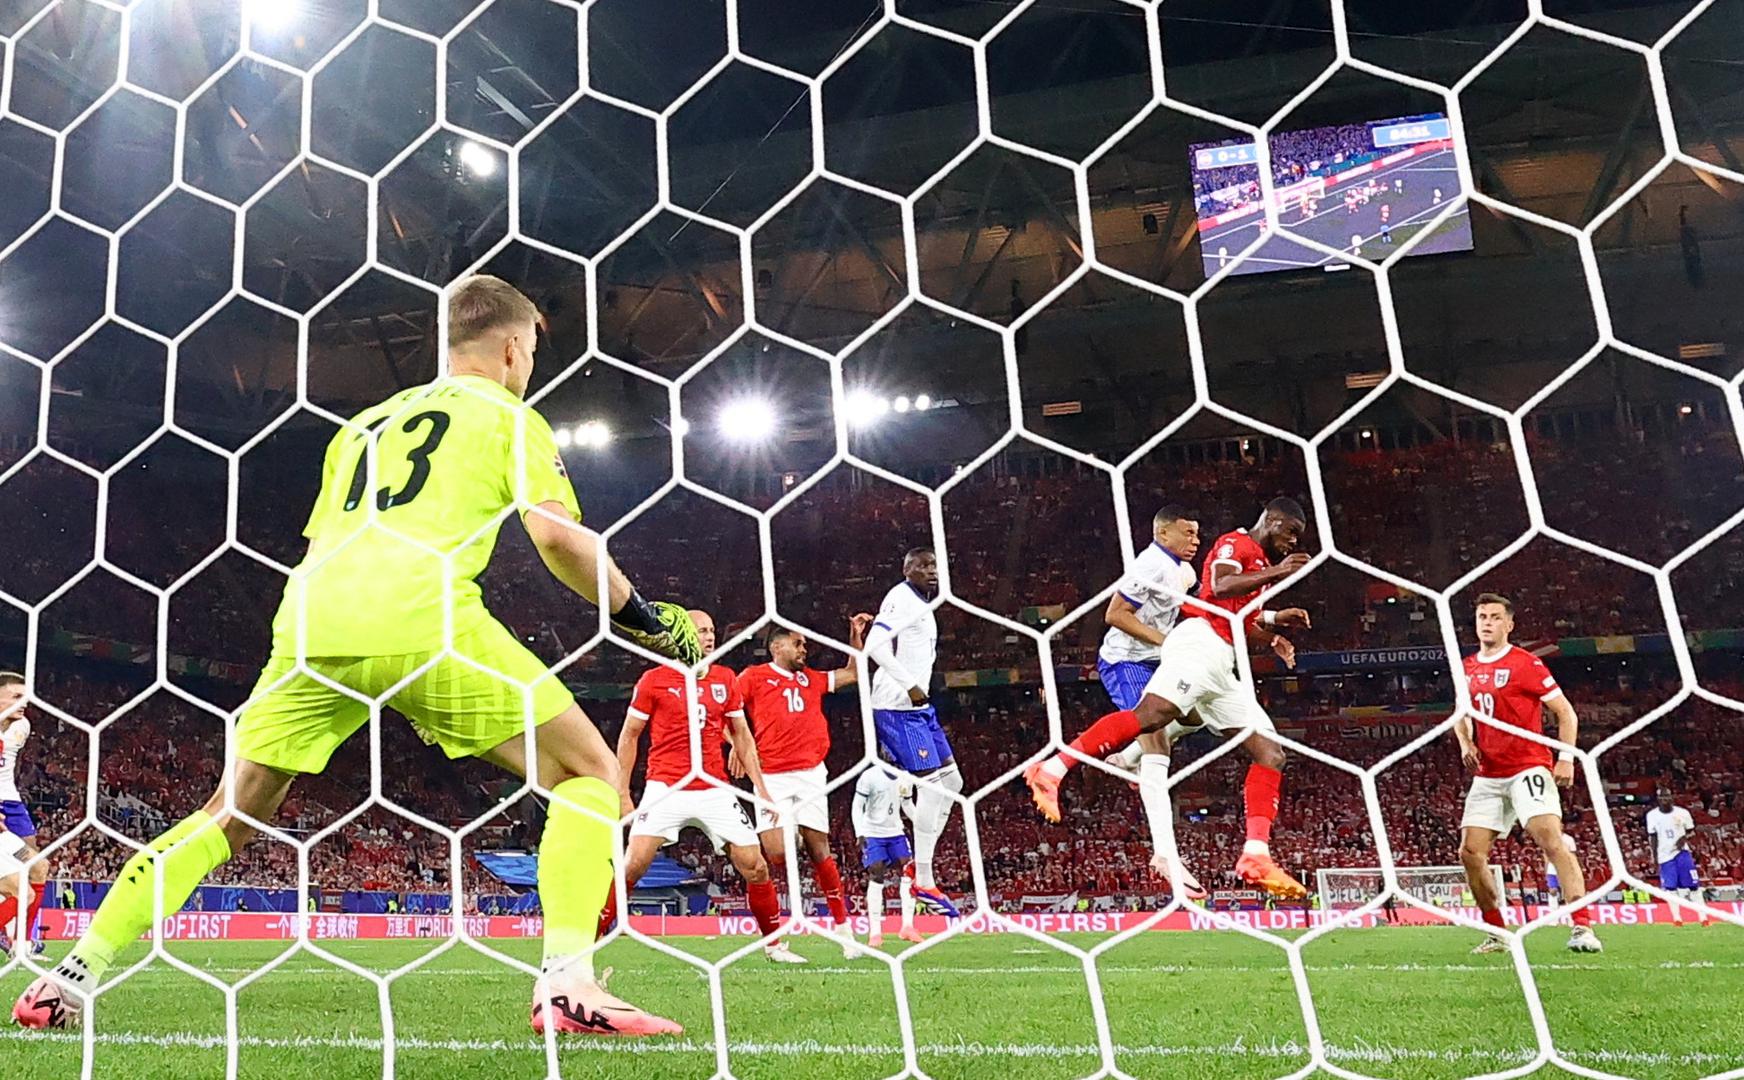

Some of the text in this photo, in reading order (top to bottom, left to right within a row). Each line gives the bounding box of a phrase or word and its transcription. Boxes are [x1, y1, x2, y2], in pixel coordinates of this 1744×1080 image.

[343, 410, 450, 512] 13
[782, 687, 805, 713] 16
[1475, 692, 1495, 719] 19
[1522, 774, 1545, 798] 19
[888, 802, 894, 816] 6
[62, 911, 95, 938] 万里
[415, 918, 490, 937] WORLDIRST
